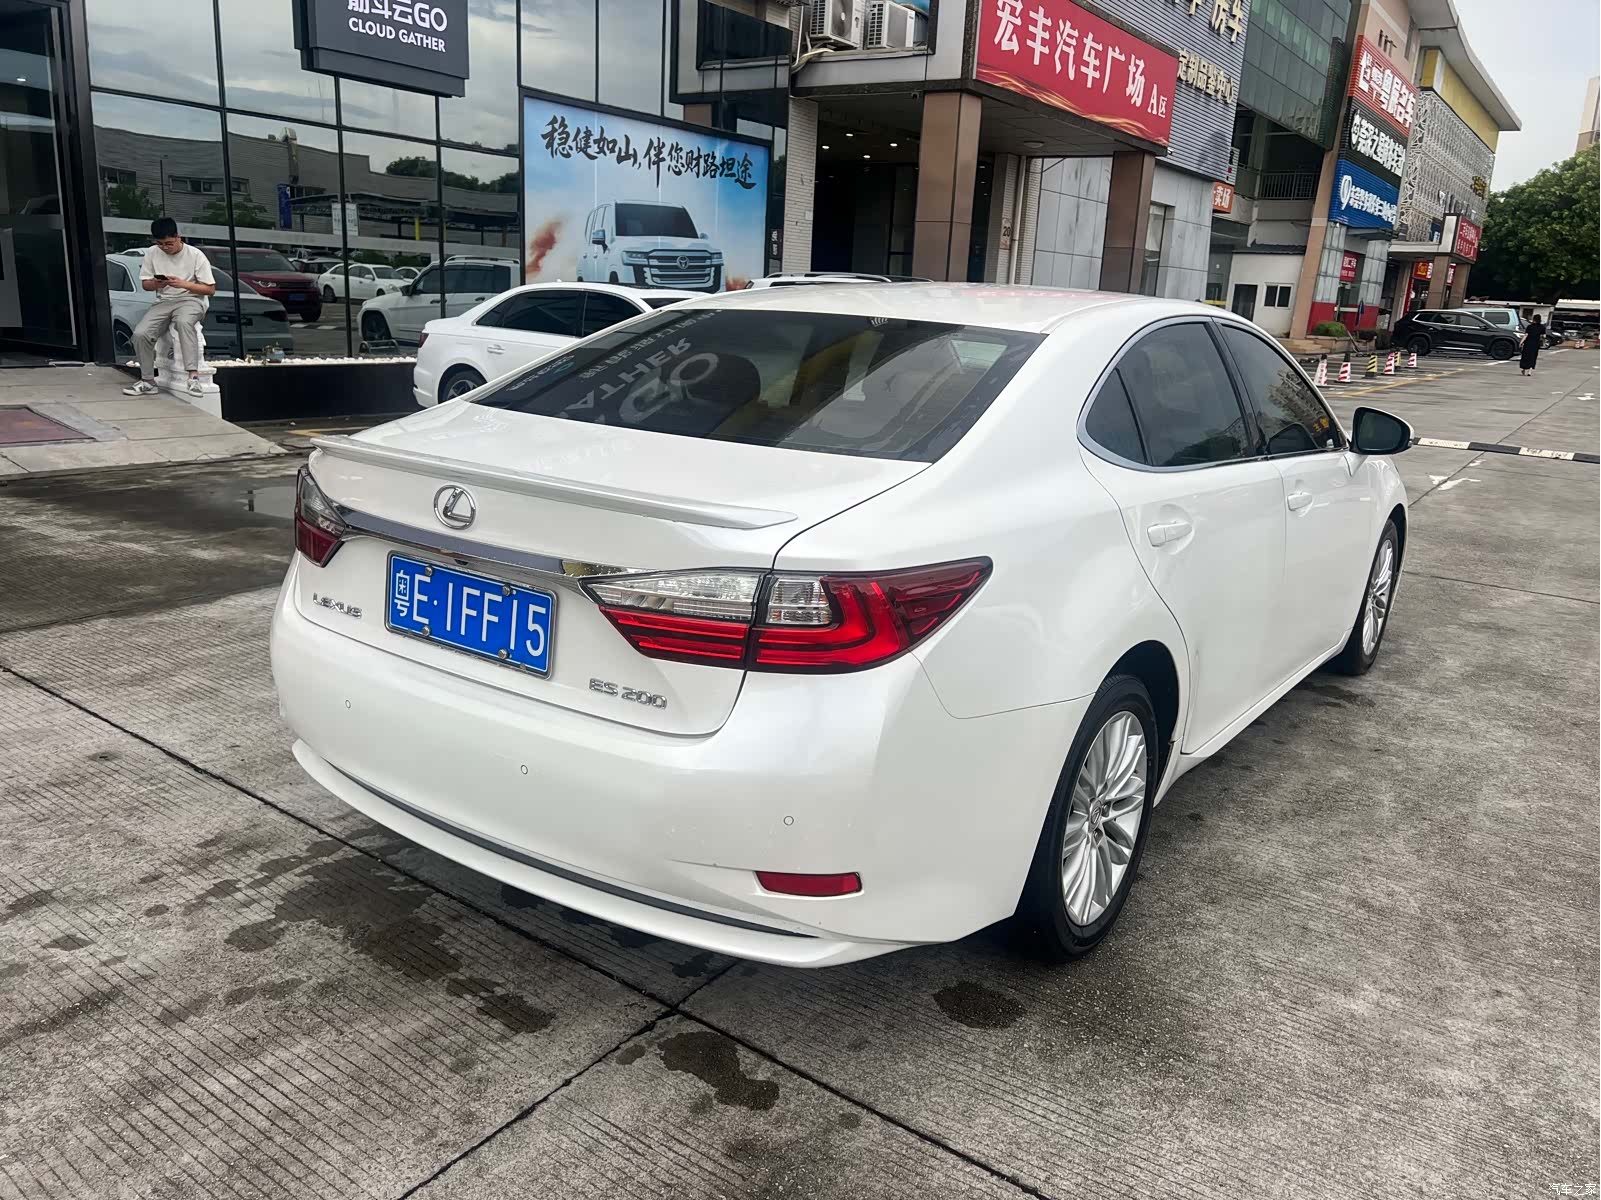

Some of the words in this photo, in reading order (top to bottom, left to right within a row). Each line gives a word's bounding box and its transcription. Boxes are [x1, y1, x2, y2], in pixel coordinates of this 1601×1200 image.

[348, 17, 396, 39] CLOUD
[398, 29, 446, 52] GATHER
[994, 0, 1145, 107] 宏丰汽车广场
[312, 593, 362, 619] LEXUS
[588, 677, 619, 697] ES
[620, 685, 668, 710] 200
